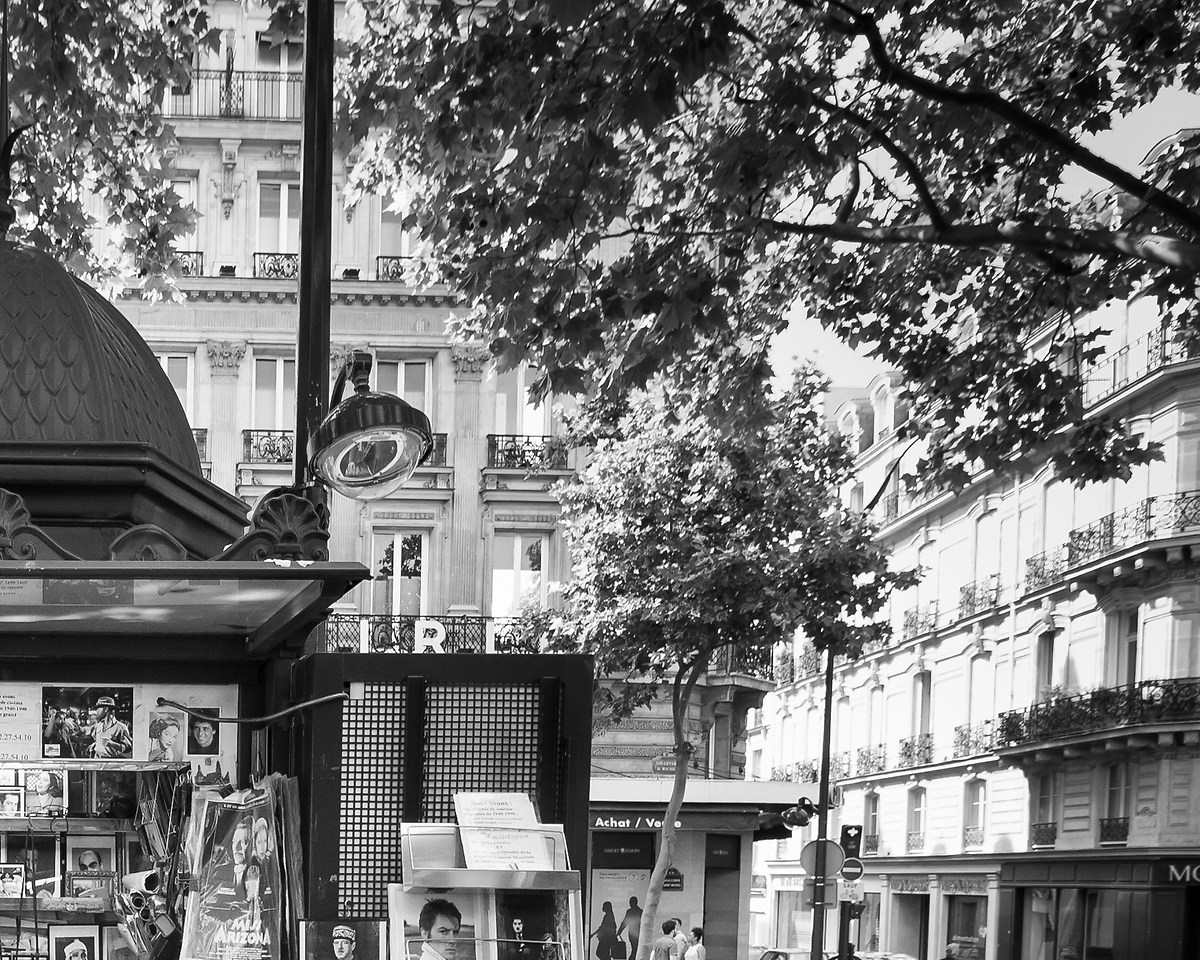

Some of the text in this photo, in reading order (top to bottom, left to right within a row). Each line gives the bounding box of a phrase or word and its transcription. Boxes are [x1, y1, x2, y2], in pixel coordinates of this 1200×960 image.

[595, 817, 681, 828] Achat / Vee
[214, 927, 270, 945] ARIZONA
